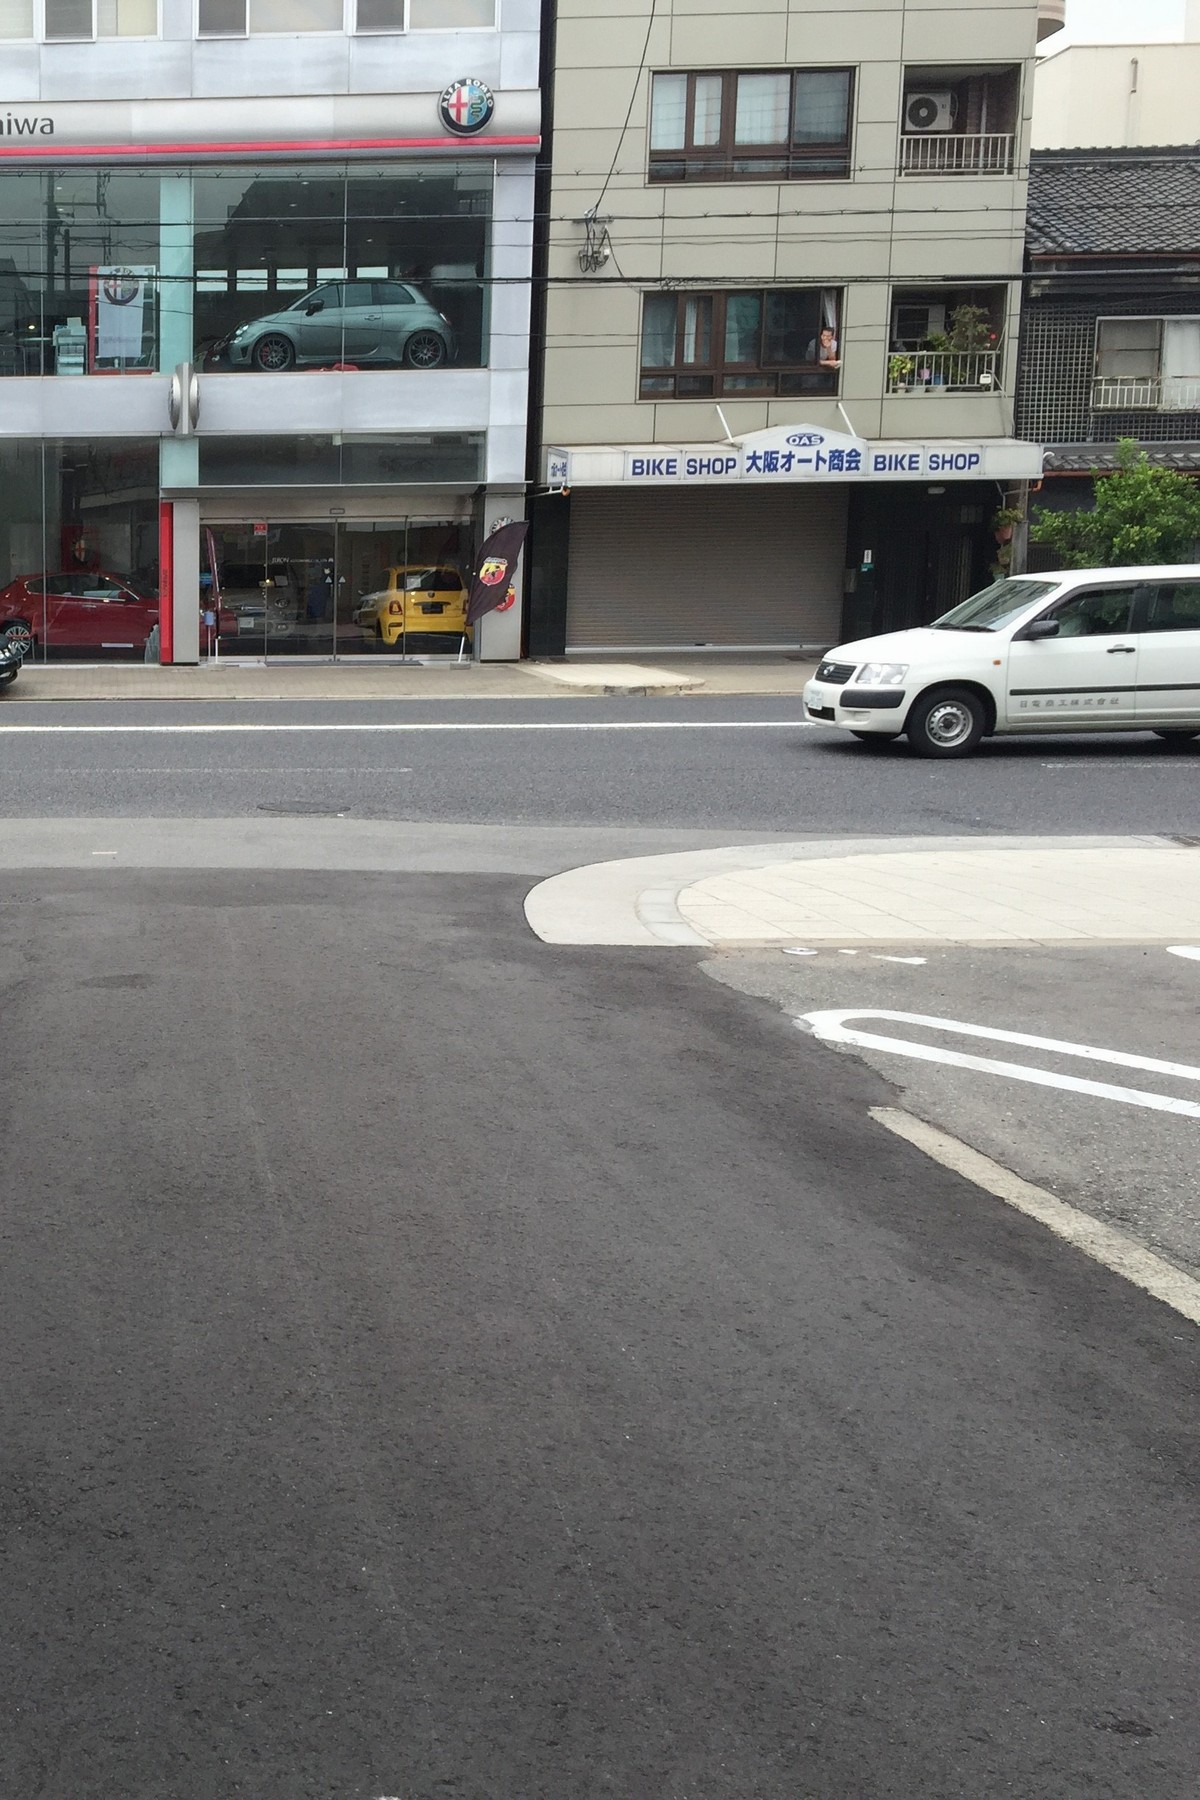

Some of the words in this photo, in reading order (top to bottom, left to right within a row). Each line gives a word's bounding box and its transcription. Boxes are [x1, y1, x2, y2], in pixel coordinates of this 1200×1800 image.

[441, 82, 461, 109] ALFA
[465, 78, 494, 107] ROMEO
[788, 435, 821, 446] OAS
[631, 458, 677, 476] BIKE
[685, 457, 737, 475] SHOP
[745, 448, 861, 474] 大阪オート商会
[873, 453, 920, 472] BIKE
[927, 452, 980, 471] SHOP
